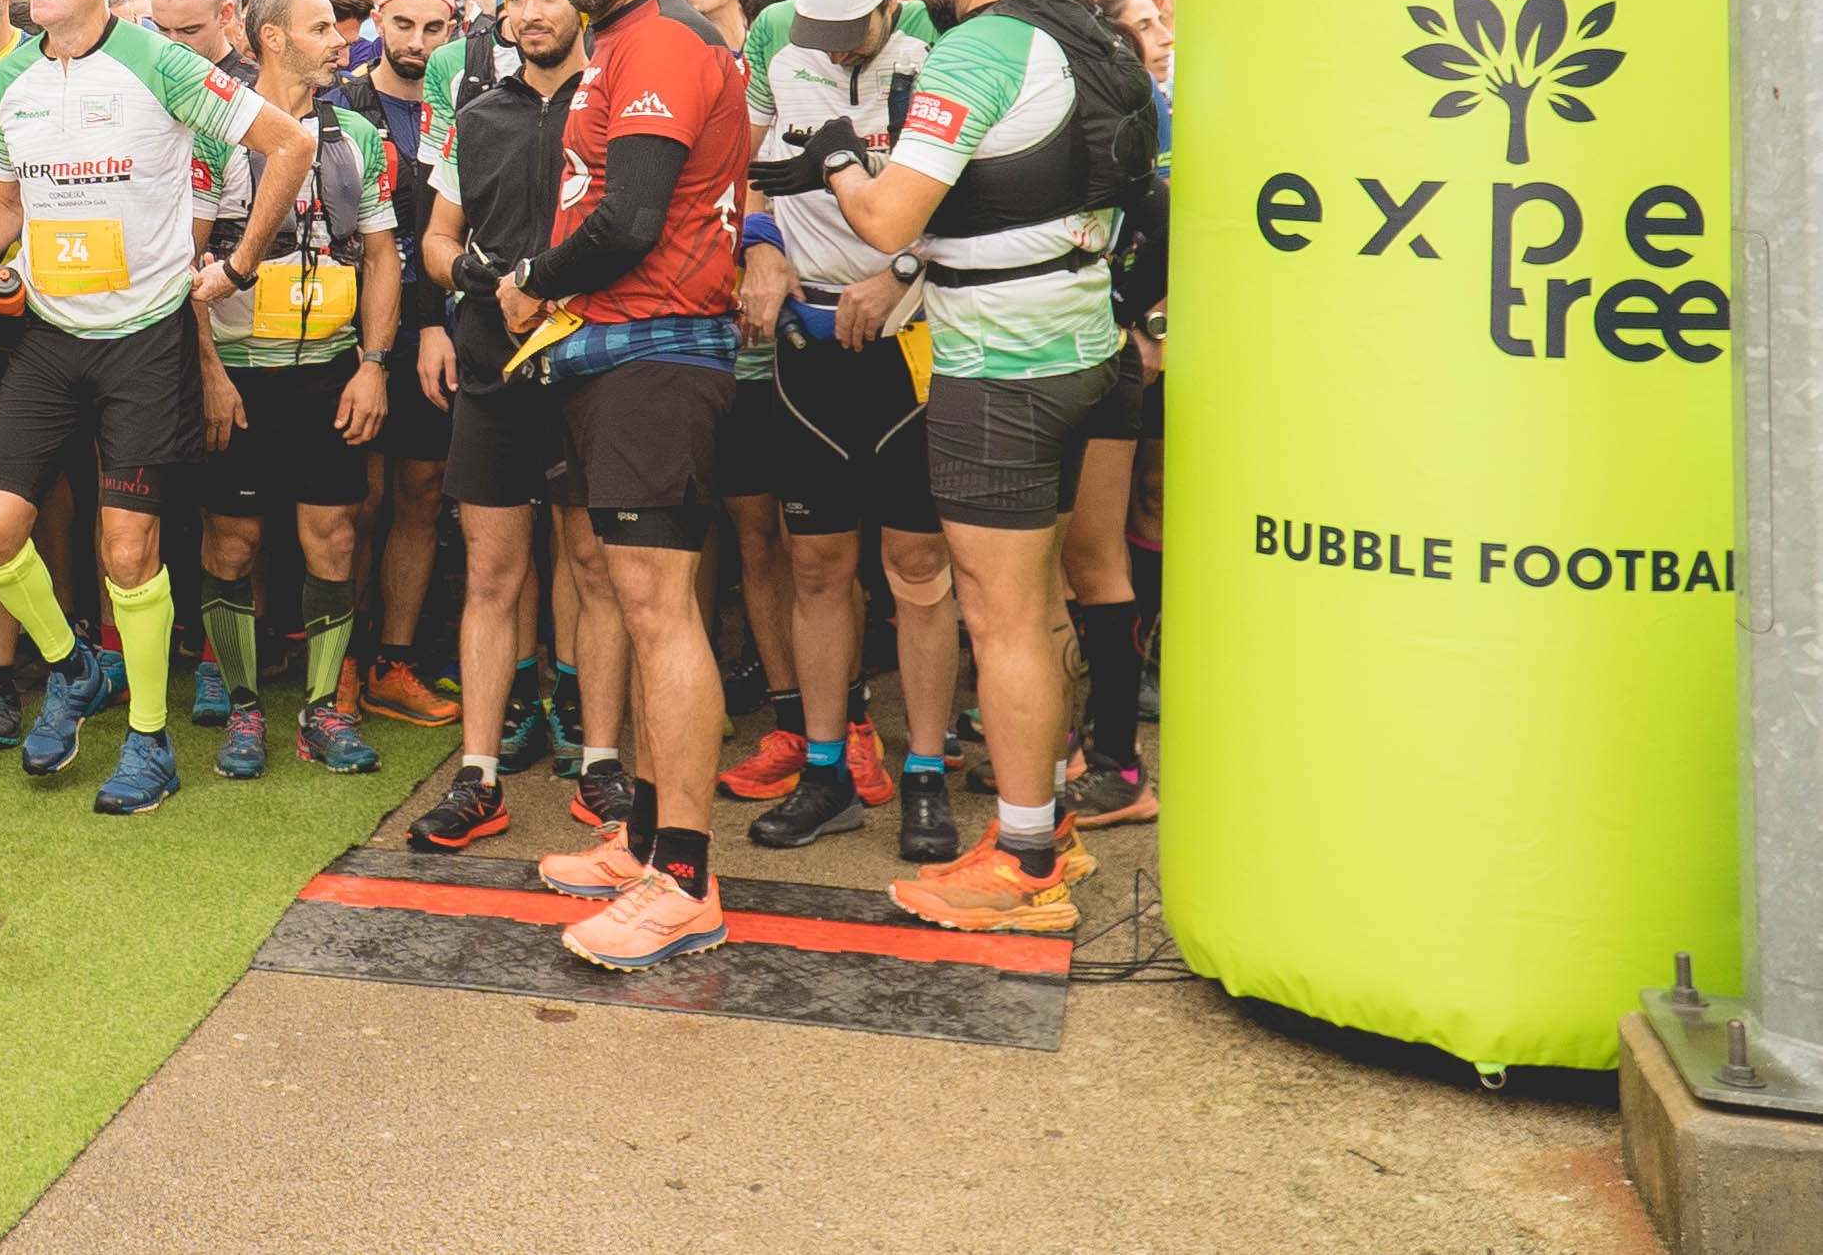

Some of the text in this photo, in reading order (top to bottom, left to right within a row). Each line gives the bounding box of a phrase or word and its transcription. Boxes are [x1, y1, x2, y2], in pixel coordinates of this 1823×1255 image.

[56, 237, 89, 262] 24
[290, 281, 324, 306] 60
[1489, 275, 1731, 363] tree
[1256, 514, 1453, 580] BUBBLE
